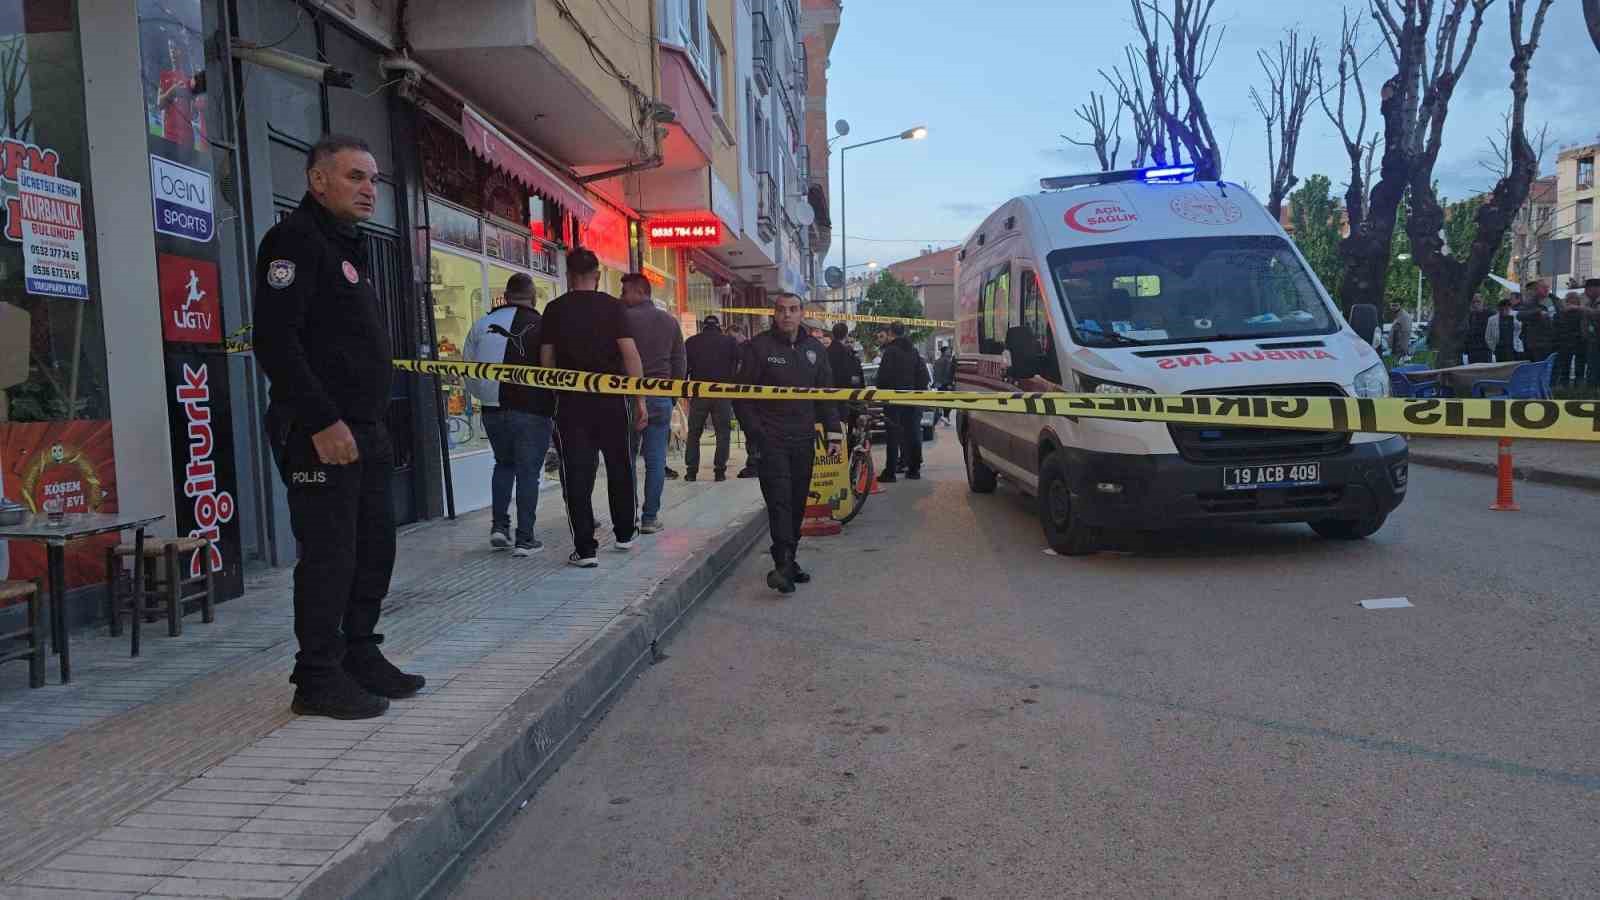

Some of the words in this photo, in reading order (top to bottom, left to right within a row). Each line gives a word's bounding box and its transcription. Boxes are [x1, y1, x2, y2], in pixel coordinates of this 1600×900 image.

[21, 194, 81, 229] KURBANLIK
[164, 208, 208, 233] SPORTS
[1233, 468, 1251, 484] 19
[1256, 465, 1285, 483] ACB
[1289, 465, 1316, 481] 409
